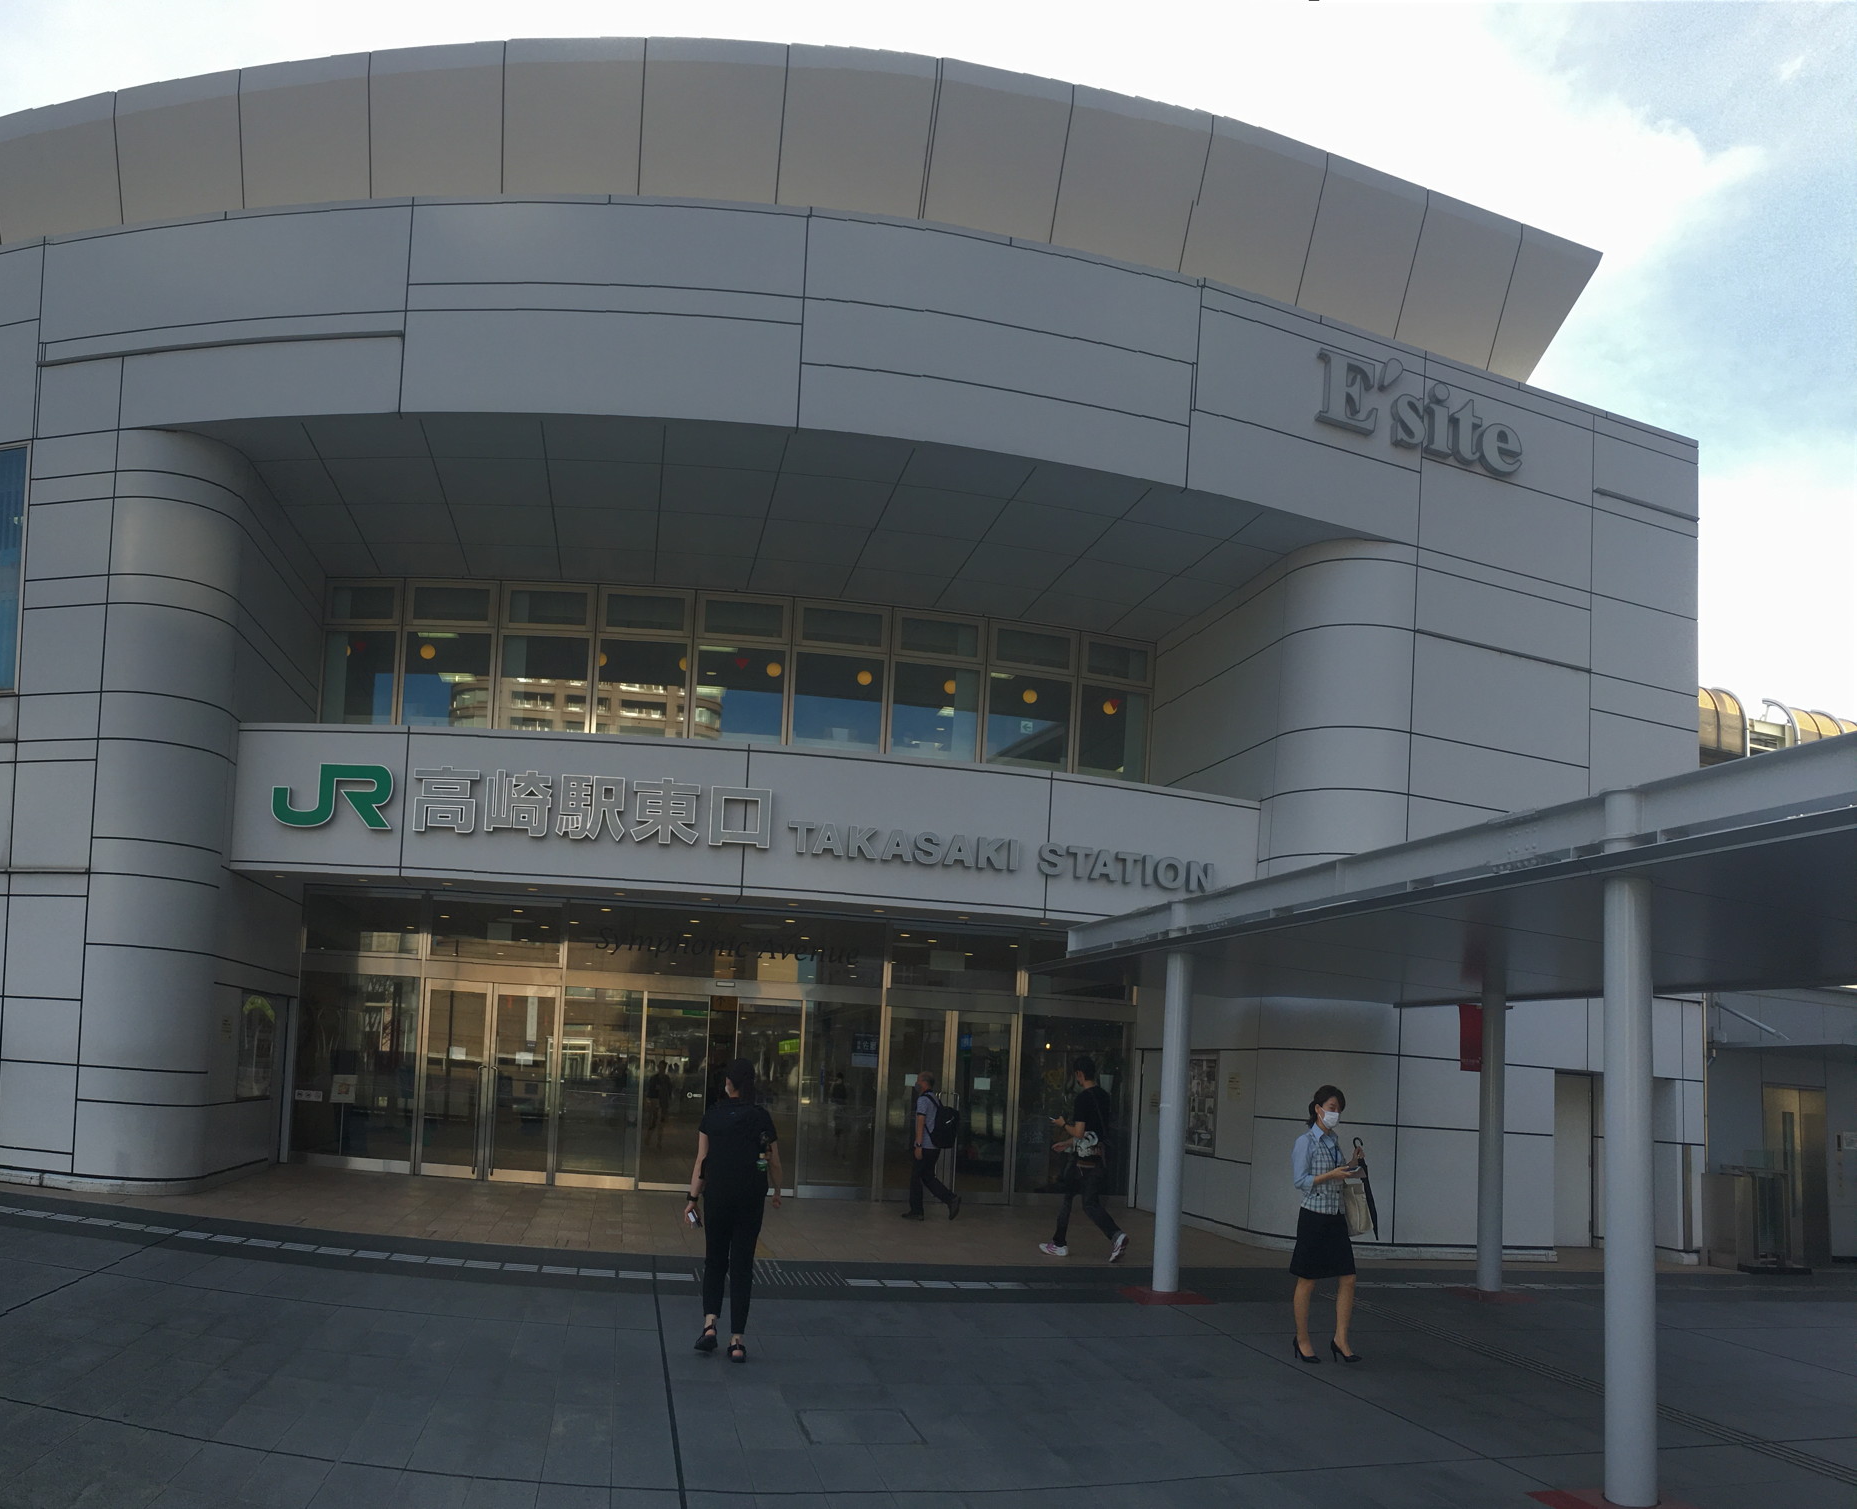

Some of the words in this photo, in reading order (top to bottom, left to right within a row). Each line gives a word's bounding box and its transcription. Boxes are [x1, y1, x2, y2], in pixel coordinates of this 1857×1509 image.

[271, 762, 394, 830] JR
[411, 765, 772, 850] 高崎駅東口
[787, 818, 1020, 872] TAKASAKI
[1038, 841, 1216, 893] STATION
[595, 926, 749, 957] Symphonic
[757, 939, 860, 965] Avenue
